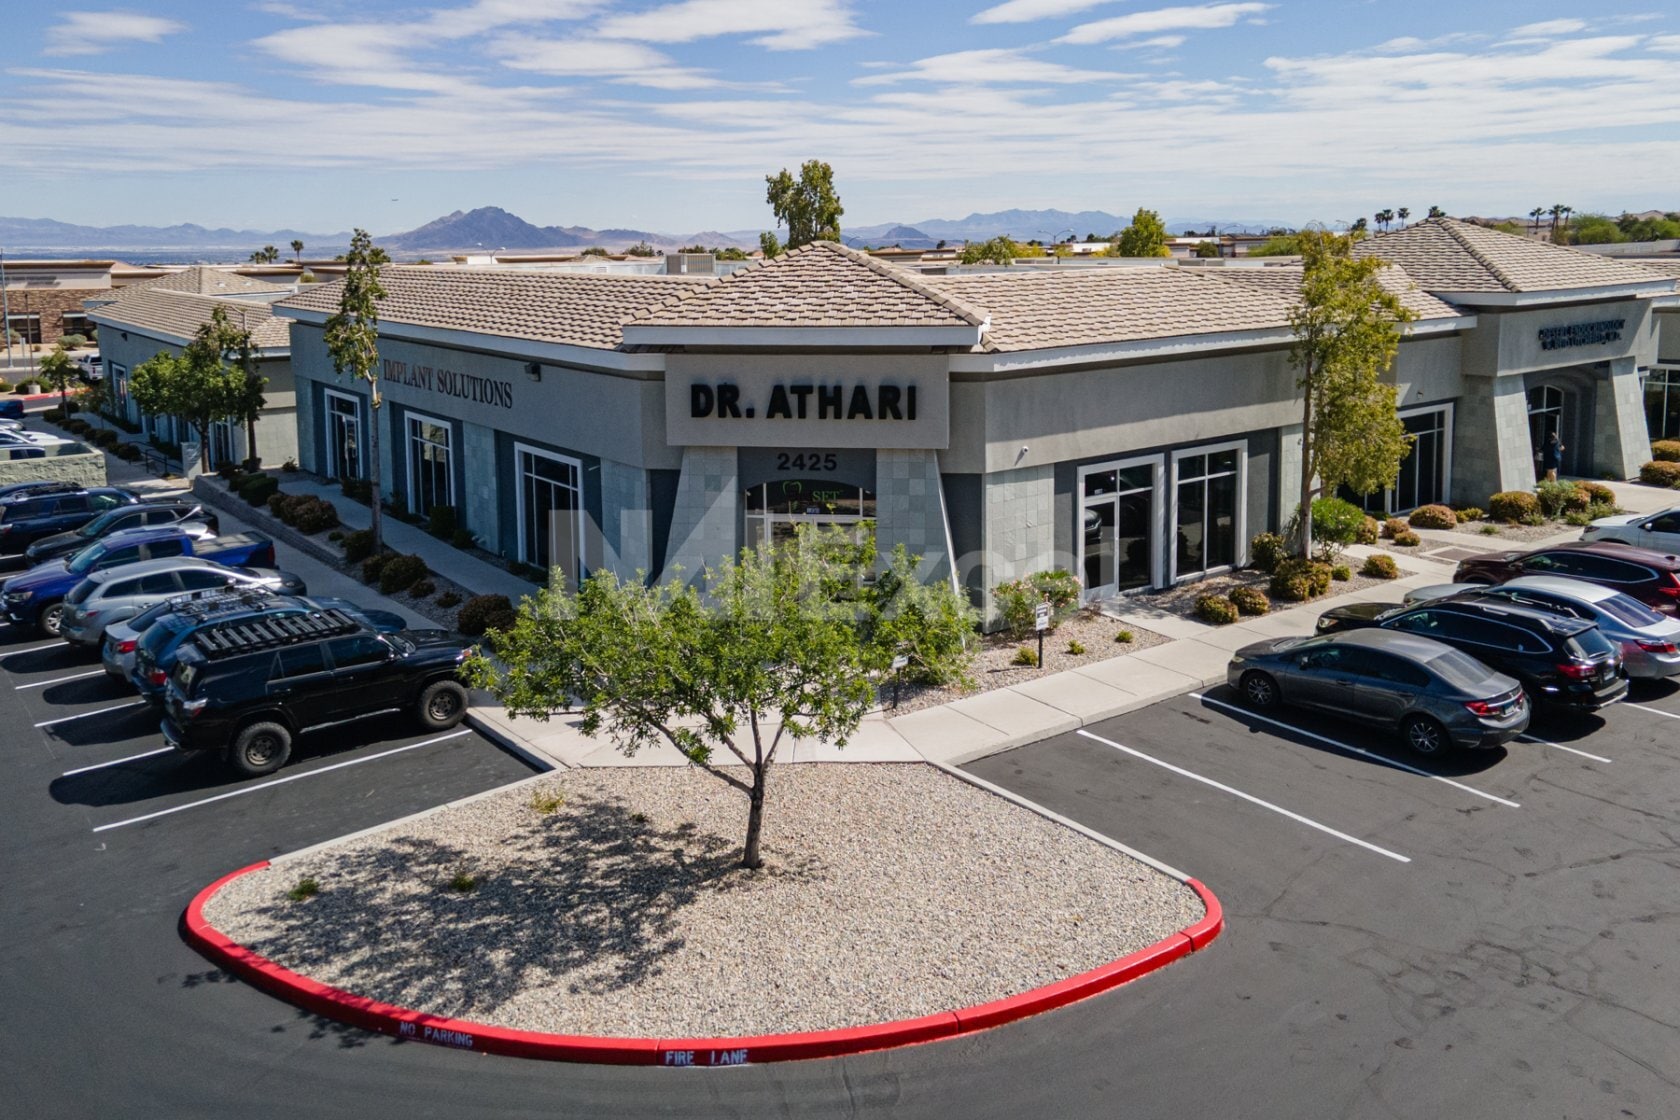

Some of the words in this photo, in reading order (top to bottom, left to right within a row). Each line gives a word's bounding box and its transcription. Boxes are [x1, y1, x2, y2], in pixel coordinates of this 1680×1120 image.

[383, 359, 433, 391] IMPLANT
[437, 369, 513, 409] SOLUTIONS
[690, 383, 755, 419] DR.
[766, 384, 917, 420] ATHARI
[777, 453, 837, 471] 2425
[400, 1021, 416, 1036] NO
[424, 1026, 473, 1046] PARKING
[665, 1050, 695, 1065] FIRE
[710, 1048, 749, 1065] LANE
